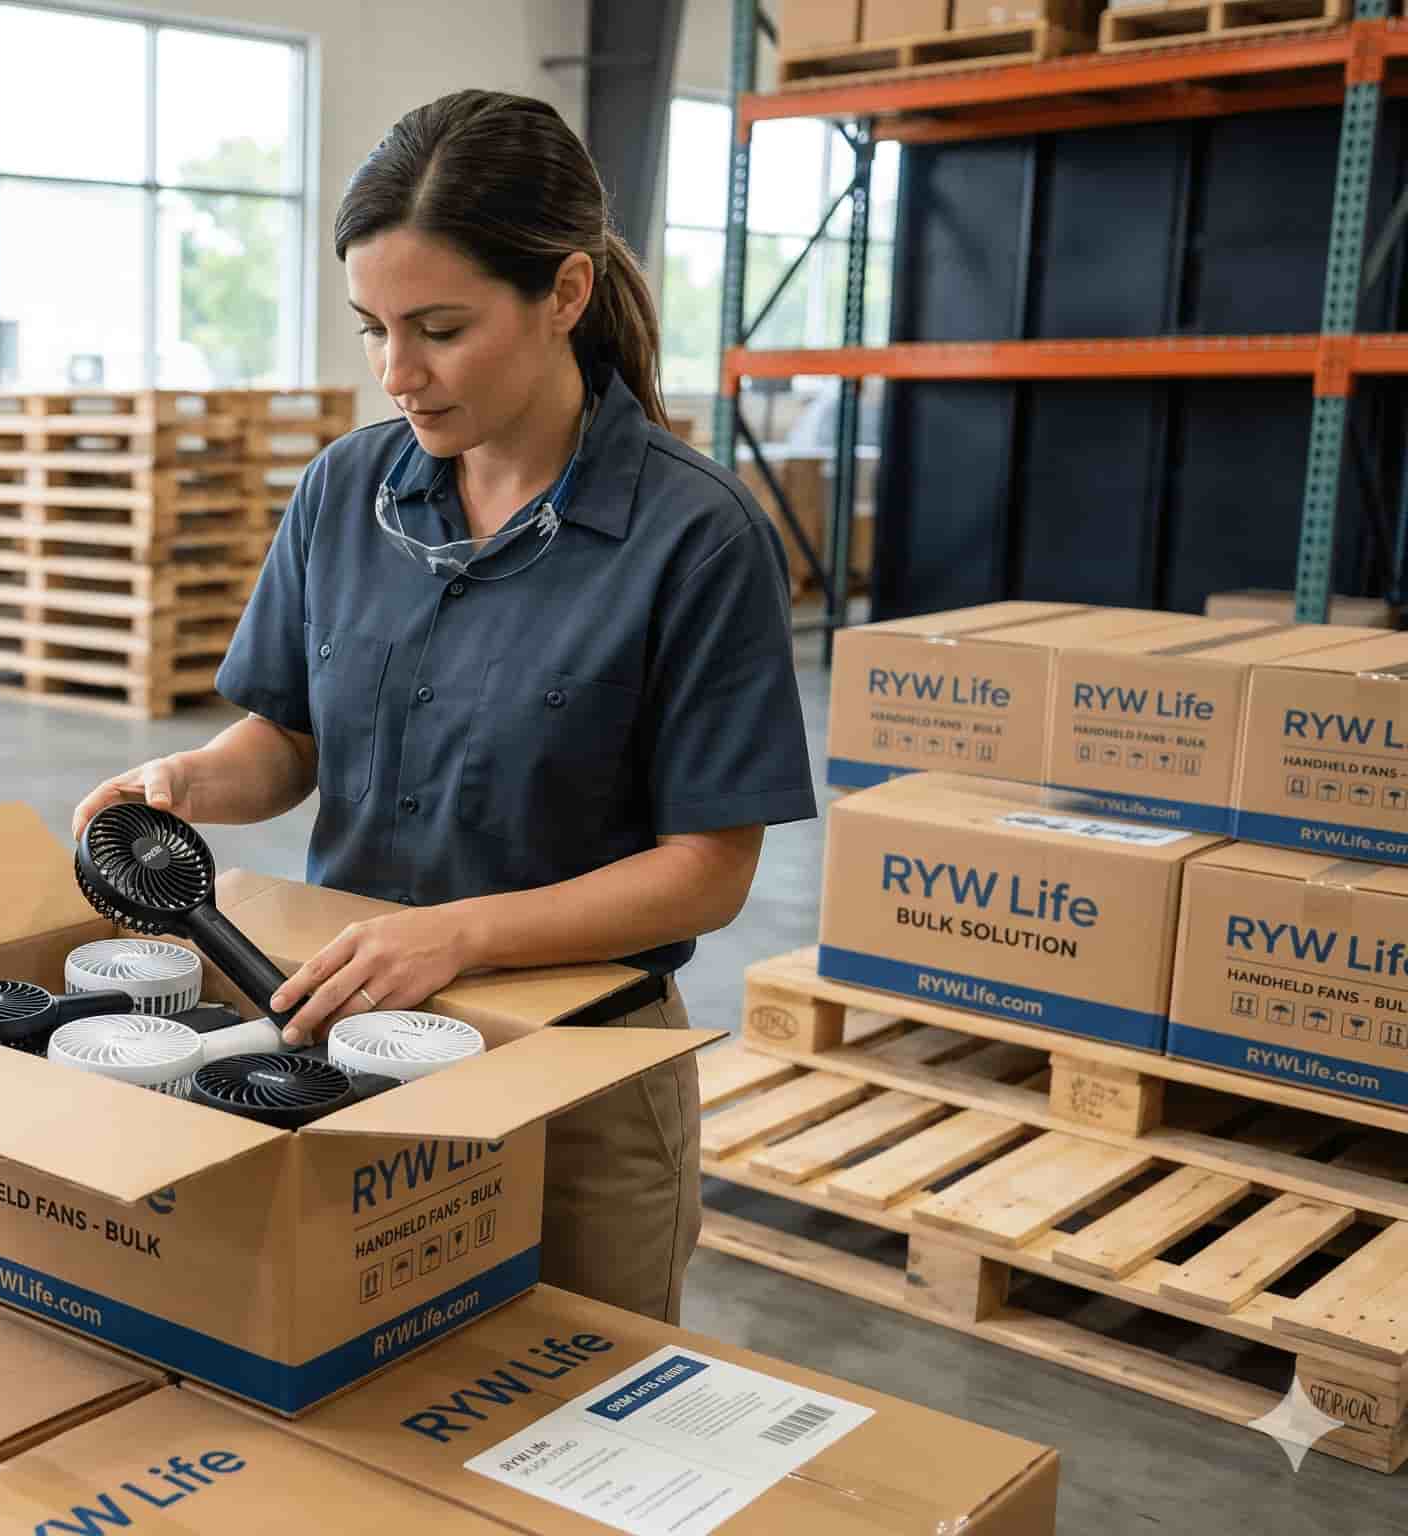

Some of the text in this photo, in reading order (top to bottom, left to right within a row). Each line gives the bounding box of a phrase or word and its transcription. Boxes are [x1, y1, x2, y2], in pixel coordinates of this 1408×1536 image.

[869, 669, 1010, 707] RYW Life
[1074, 683, 1214, 720] RYW Life
[1283, 709, 1376, 745] RYW
[1283, 755, 1358, 774] HANDHELD
[1362, 766, 1397, 779] FANS
[882, 853, 1099, 928] RYW Life
[896, 906, 1078, 958] BULK SOLUTION
[1226, 914, 1338, 964] RYW
[917, 973, 1043, 1016] RYWLife.com
[1227, 967, 1314, 995] HANDHELD
[1318, 985, 1360, 1004] FANS
[1245, 1047, 1380, 1091] RYWLife.com
[353, 1140, 439, 1215] RYW
[36, 1196, 88, 1231] FANS
[105, 1219, 161, 1258] BULK
[355, 1214, 427, 1260] HANDHELD
[429, 1198, 461, 1227] FANS
[471, 1177, 503, 1207] BULK
[374, 1290, 480, 1360] RYWLife.com
[400, 1332, 615, 1444] RYW Life
[121, 1450, 247, 1508] Life
